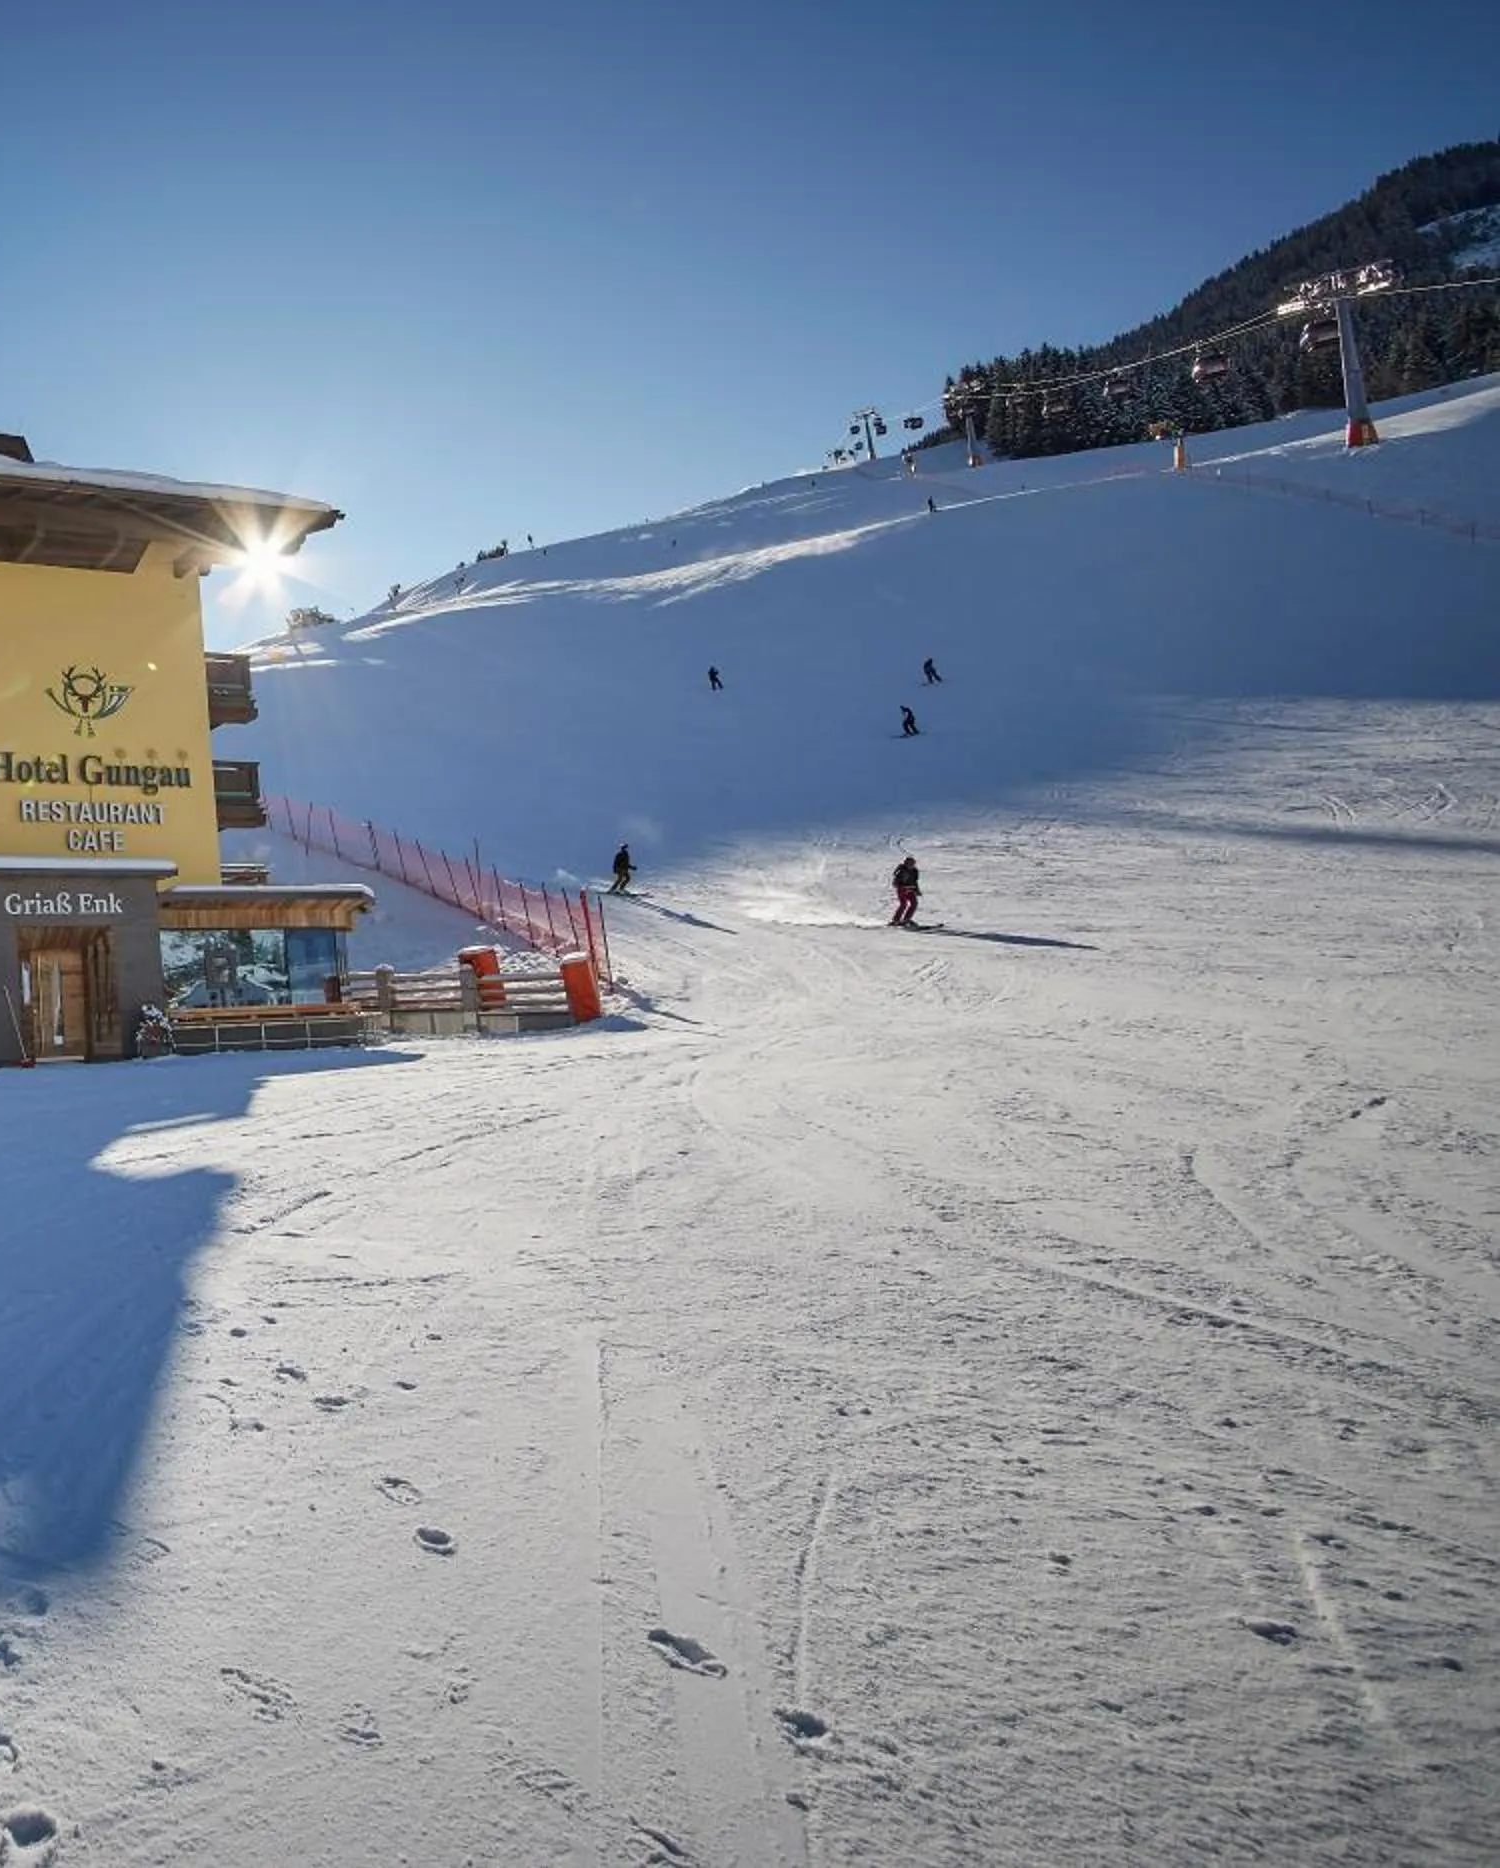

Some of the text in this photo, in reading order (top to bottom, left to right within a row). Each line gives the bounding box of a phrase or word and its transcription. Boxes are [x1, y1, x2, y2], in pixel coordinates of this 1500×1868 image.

[79, 755, 192, 796] Gungau
[20, 800, 166, 825] RESTAURANT
[67, 829, 126, 852] CAFE
[4, 891, 123, 916] Griaß Enk
